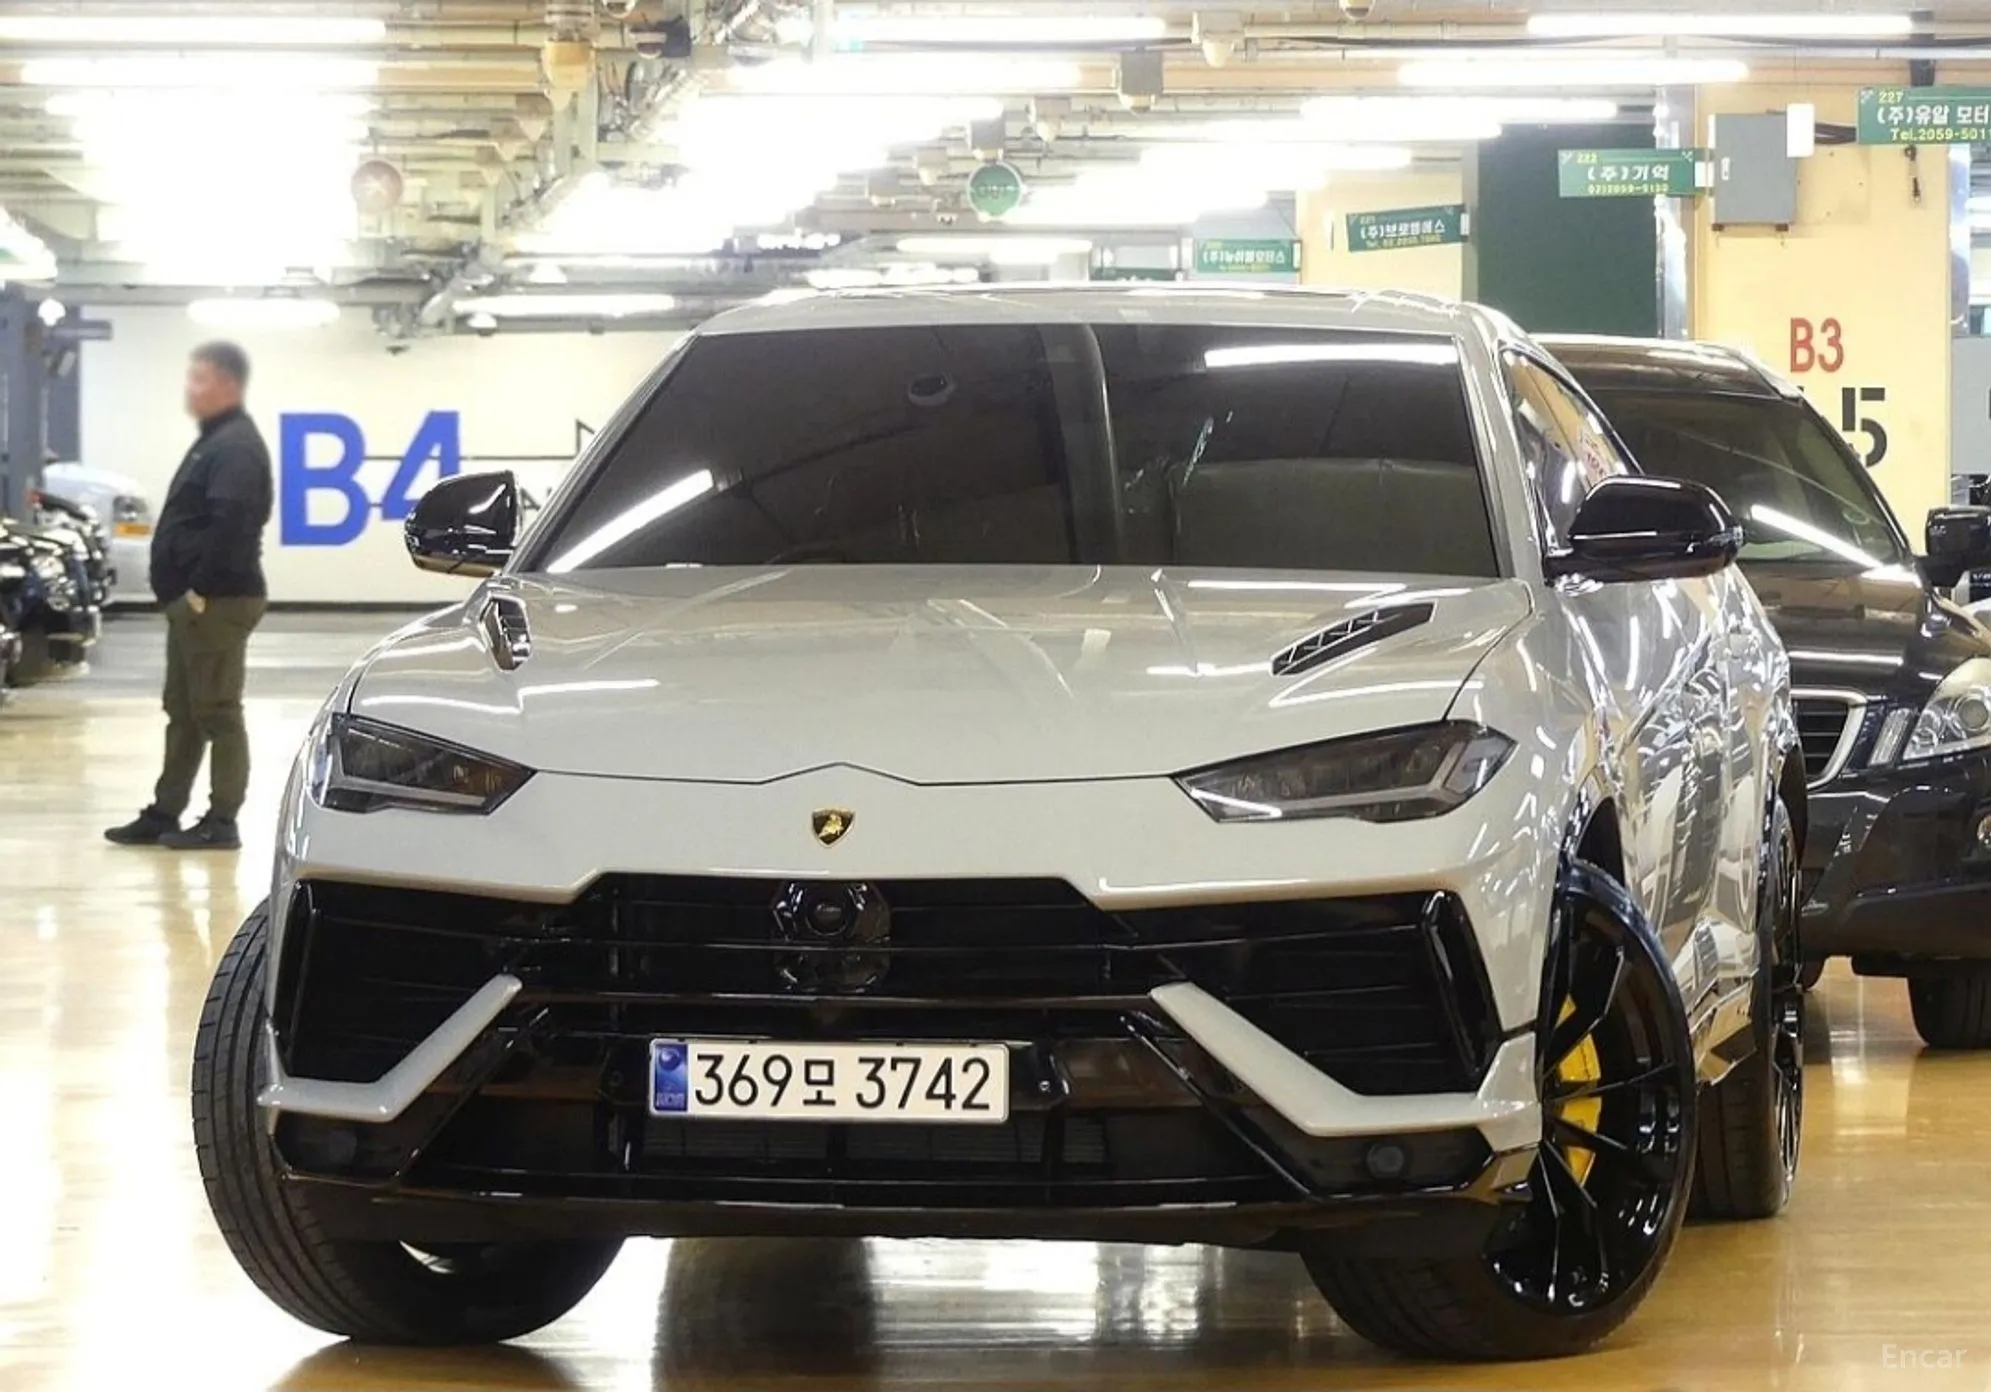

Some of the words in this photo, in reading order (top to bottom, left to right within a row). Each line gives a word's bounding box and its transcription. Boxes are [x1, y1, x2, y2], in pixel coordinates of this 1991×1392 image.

[1879, 90, 1904, 104] 227
[1790, 317, 1844, 374] B3
[279, 410, 461, 547] B4
[856, 1057, 991, 1111] 3742
